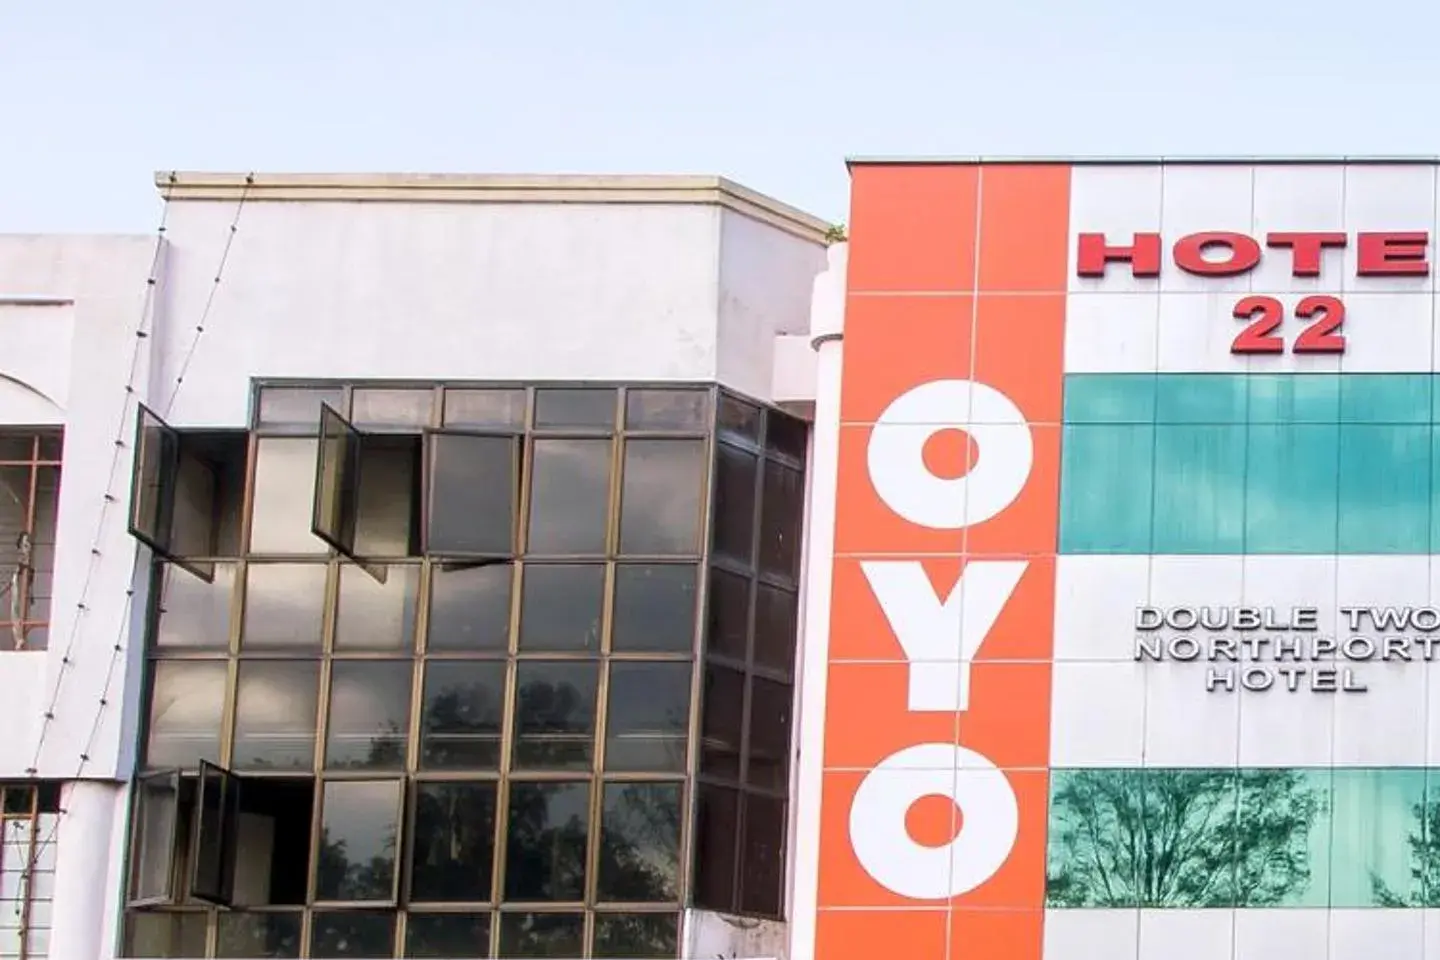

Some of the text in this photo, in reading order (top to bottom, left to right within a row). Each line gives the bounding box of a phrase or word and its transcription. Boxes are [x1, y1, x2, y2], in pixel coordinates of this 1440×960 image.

[1231, 295, 1345, 354] 22
[1135, 606, 1318, 630] DOUBLE
[848, 379, 1034, 900] OYO
[1206, 669, 1368, 692] HOTEL
